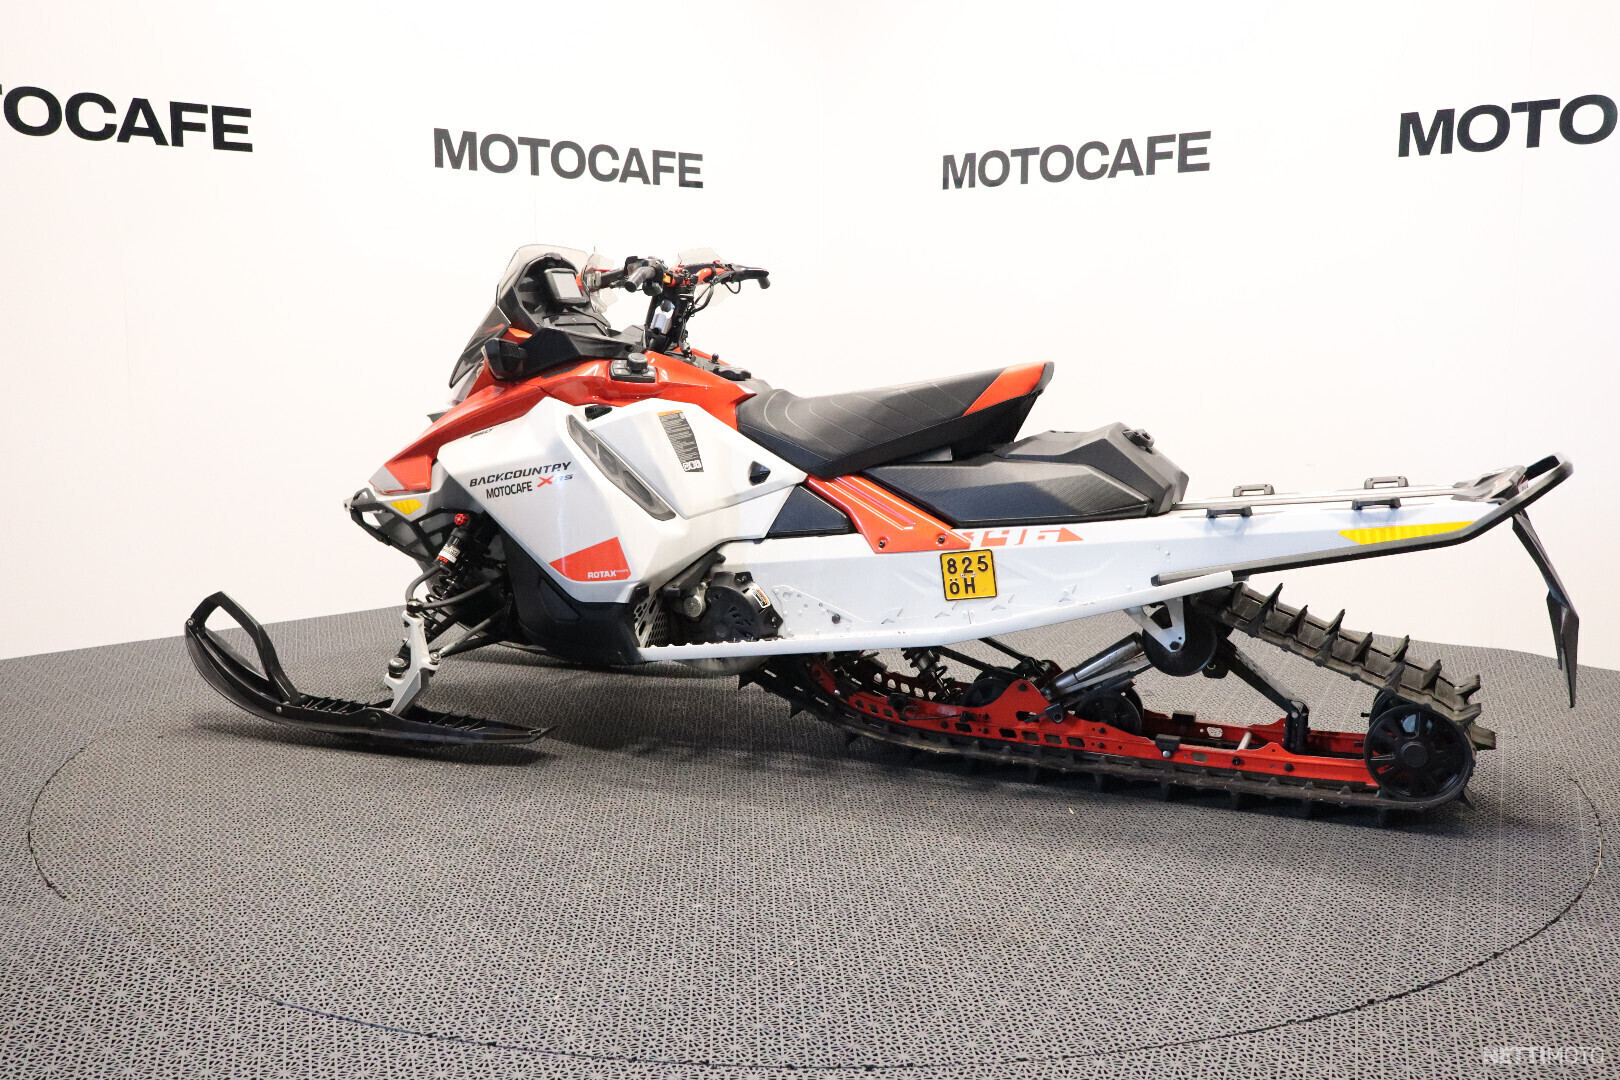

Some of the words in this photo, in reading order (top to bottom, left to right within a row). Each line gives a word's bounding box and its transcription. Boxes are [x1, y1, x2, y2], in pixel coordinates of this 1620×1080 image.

[0, 84, 253, 153] OCAFE
[1398, 94, 1618, 158] MOTO
[433, 127, 704, 189] MOTOCAFE
[942, 130, 1212, 190] MOTOCAFE
[469, 461, 572, 487] BACKCOUNTRY
[486, 481, 533, 499] MOTOCAFE
[587, 569, 617, 579] ROTAX
[946, 554, 989, 575] 825
[949, 576, 976, 595] ÖH
